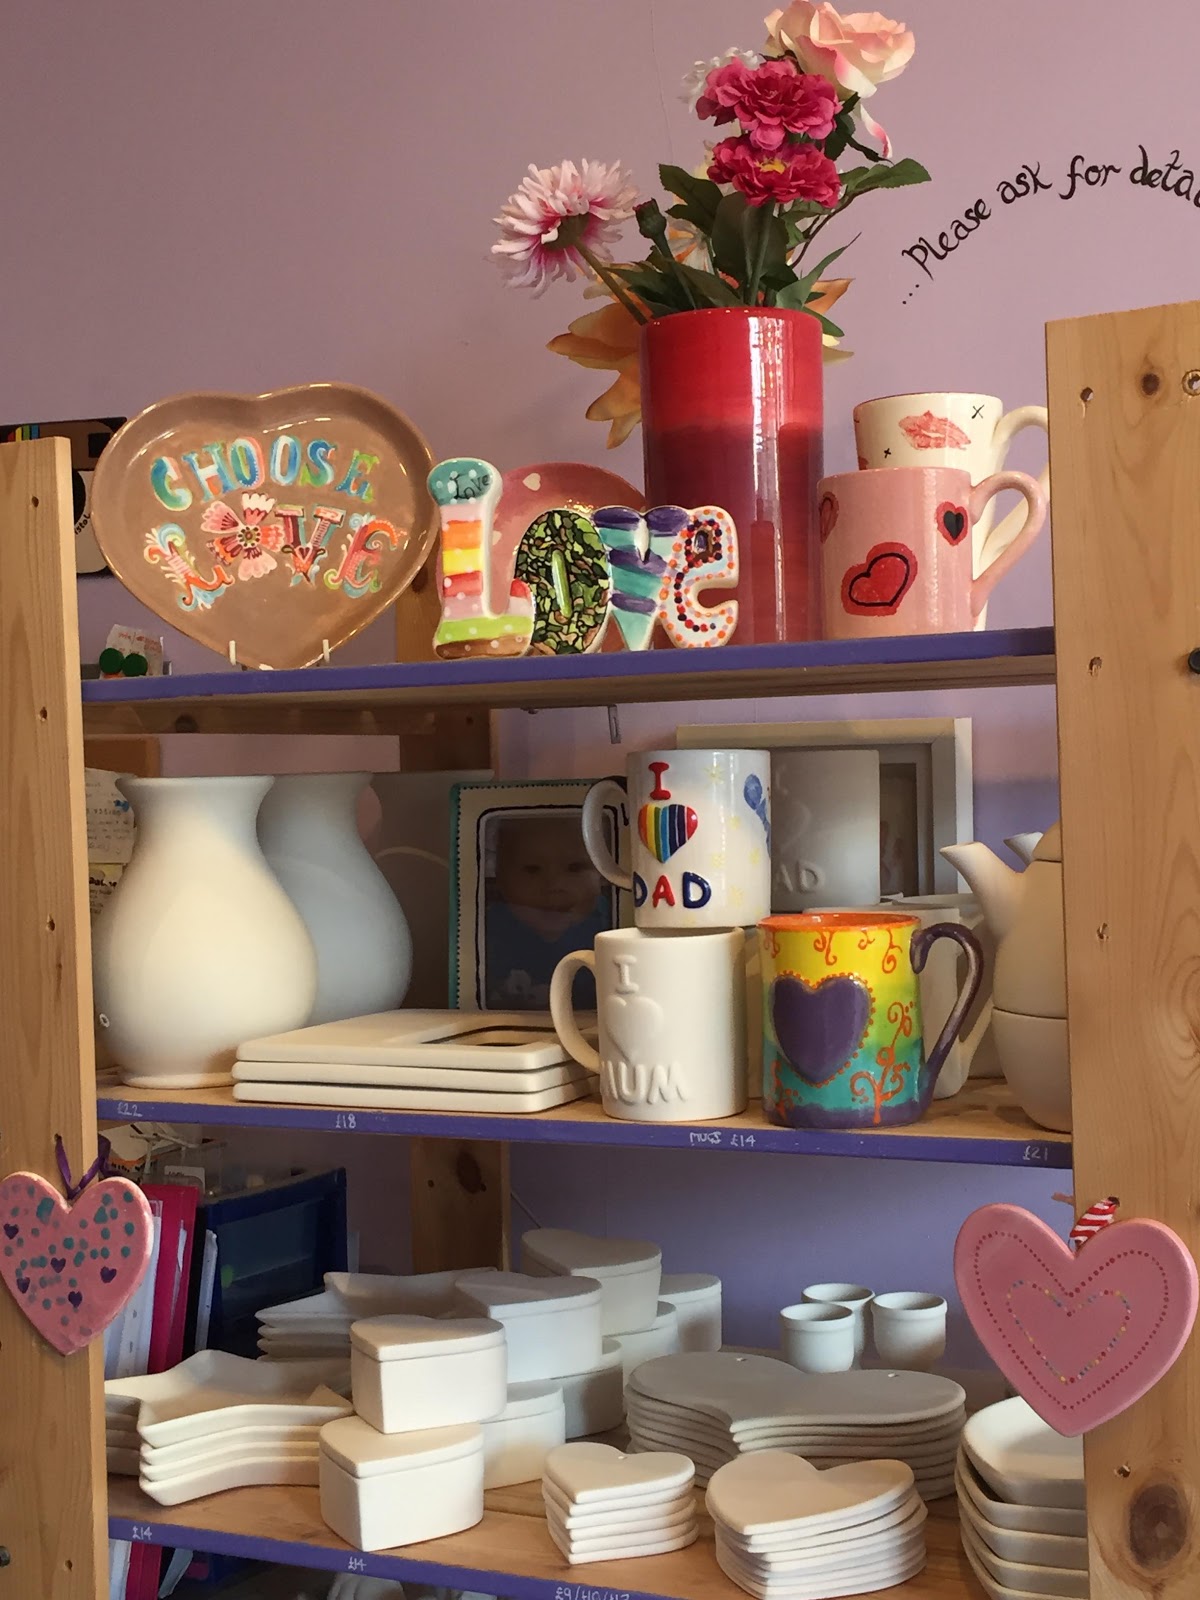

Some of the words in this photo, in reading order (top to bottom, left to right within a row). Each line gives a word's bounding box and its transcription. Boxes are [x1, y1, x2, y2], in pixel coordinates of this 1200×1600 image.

[996, 162, 1053, 205] ask
[1058, 155, 1122, 200] for
[150, 434, 381, 512] CHOOSE
[452, 473, 490, 501] Love
[648, 761, 672, 801] I
[632, 870, 712, 909] DAD
[613, 954, 640, 995] I
[117, 1101, 143, 1118] £22
[335, 1113, 357, 1129] £18
[730, 1133, 756, 1147] £14
[1022, 1145, 1048, 1161] £21
[132, 1525, 153, 1541] £14
